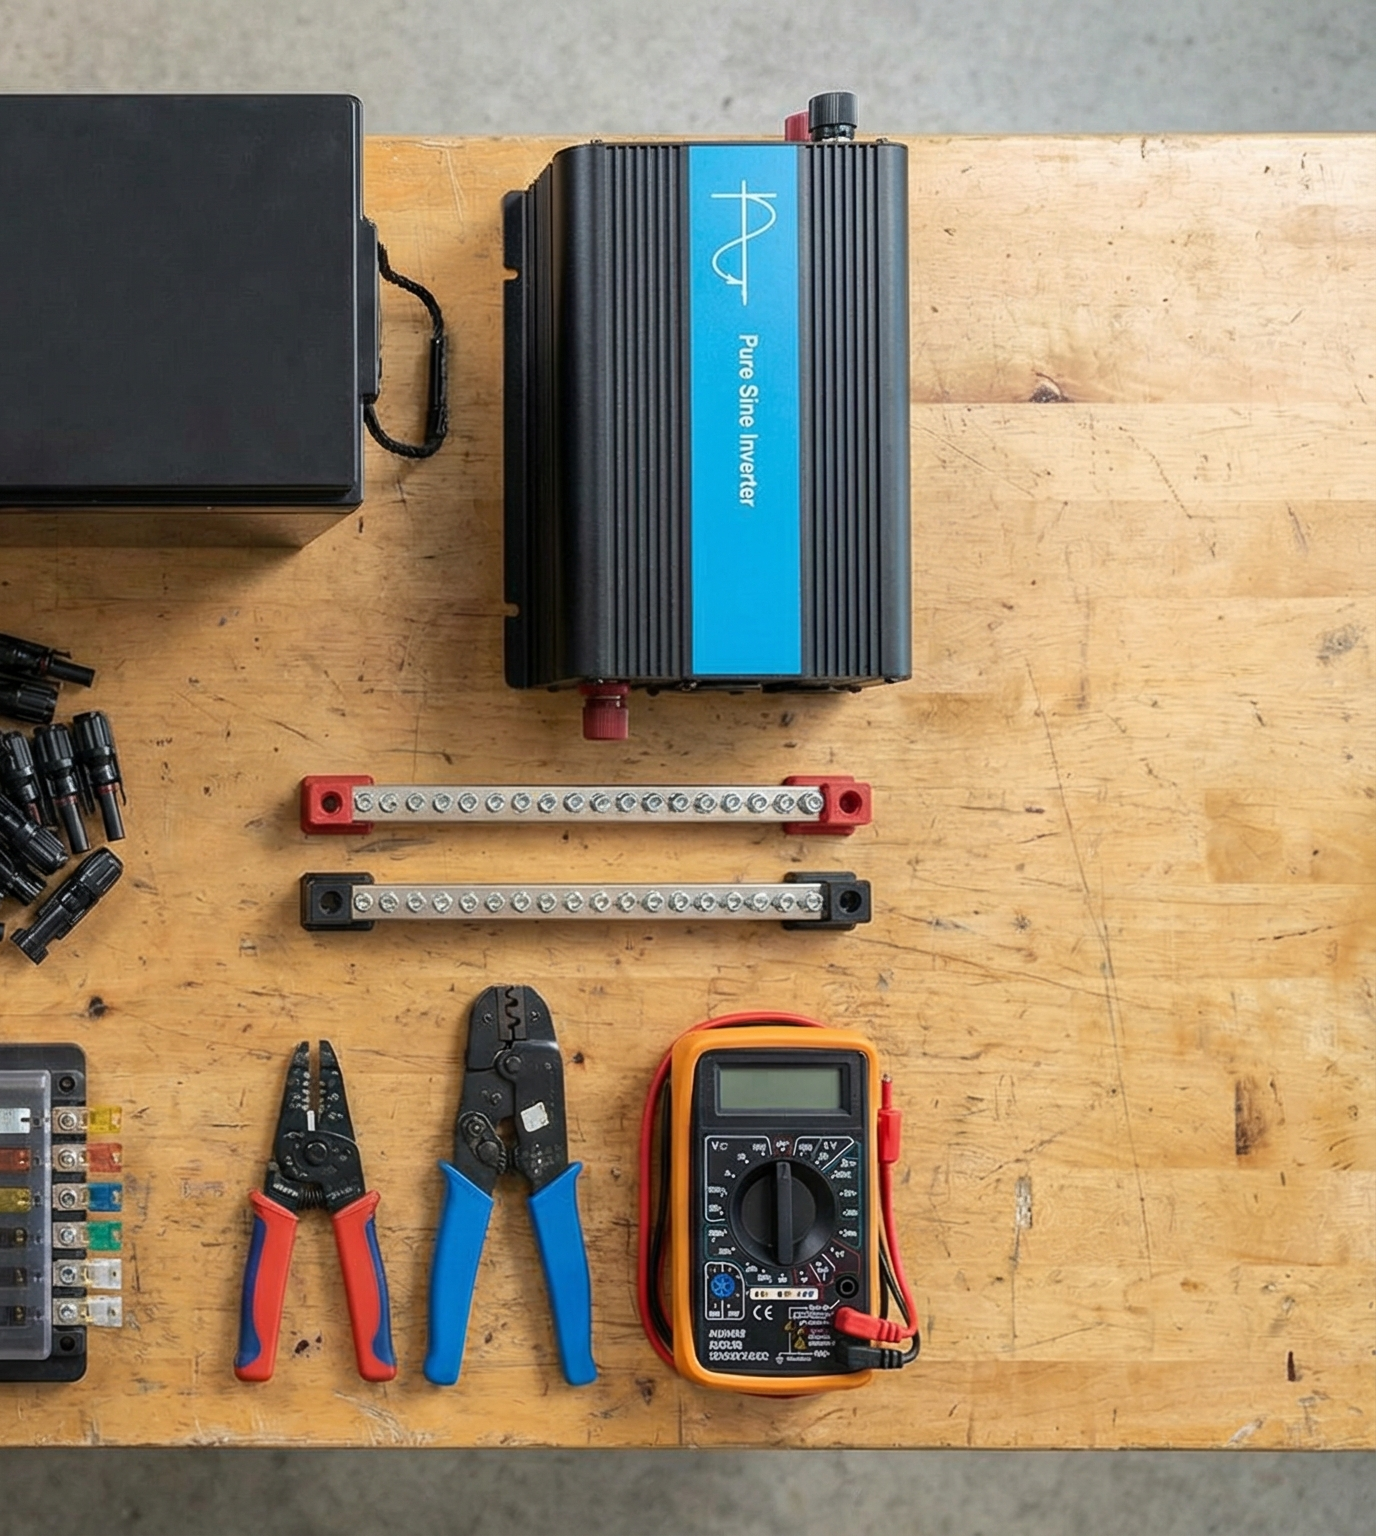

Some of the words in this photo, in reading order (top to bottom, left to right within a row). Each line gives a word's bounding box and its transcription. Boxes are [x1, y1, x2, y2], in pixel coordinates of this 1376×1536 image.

[738, 334, 759, 380] Pure
[738, 384, 759, 428] Sine
[738, 434, 759, 507] Inverter
[752, 1304, 774, 1321] CE
